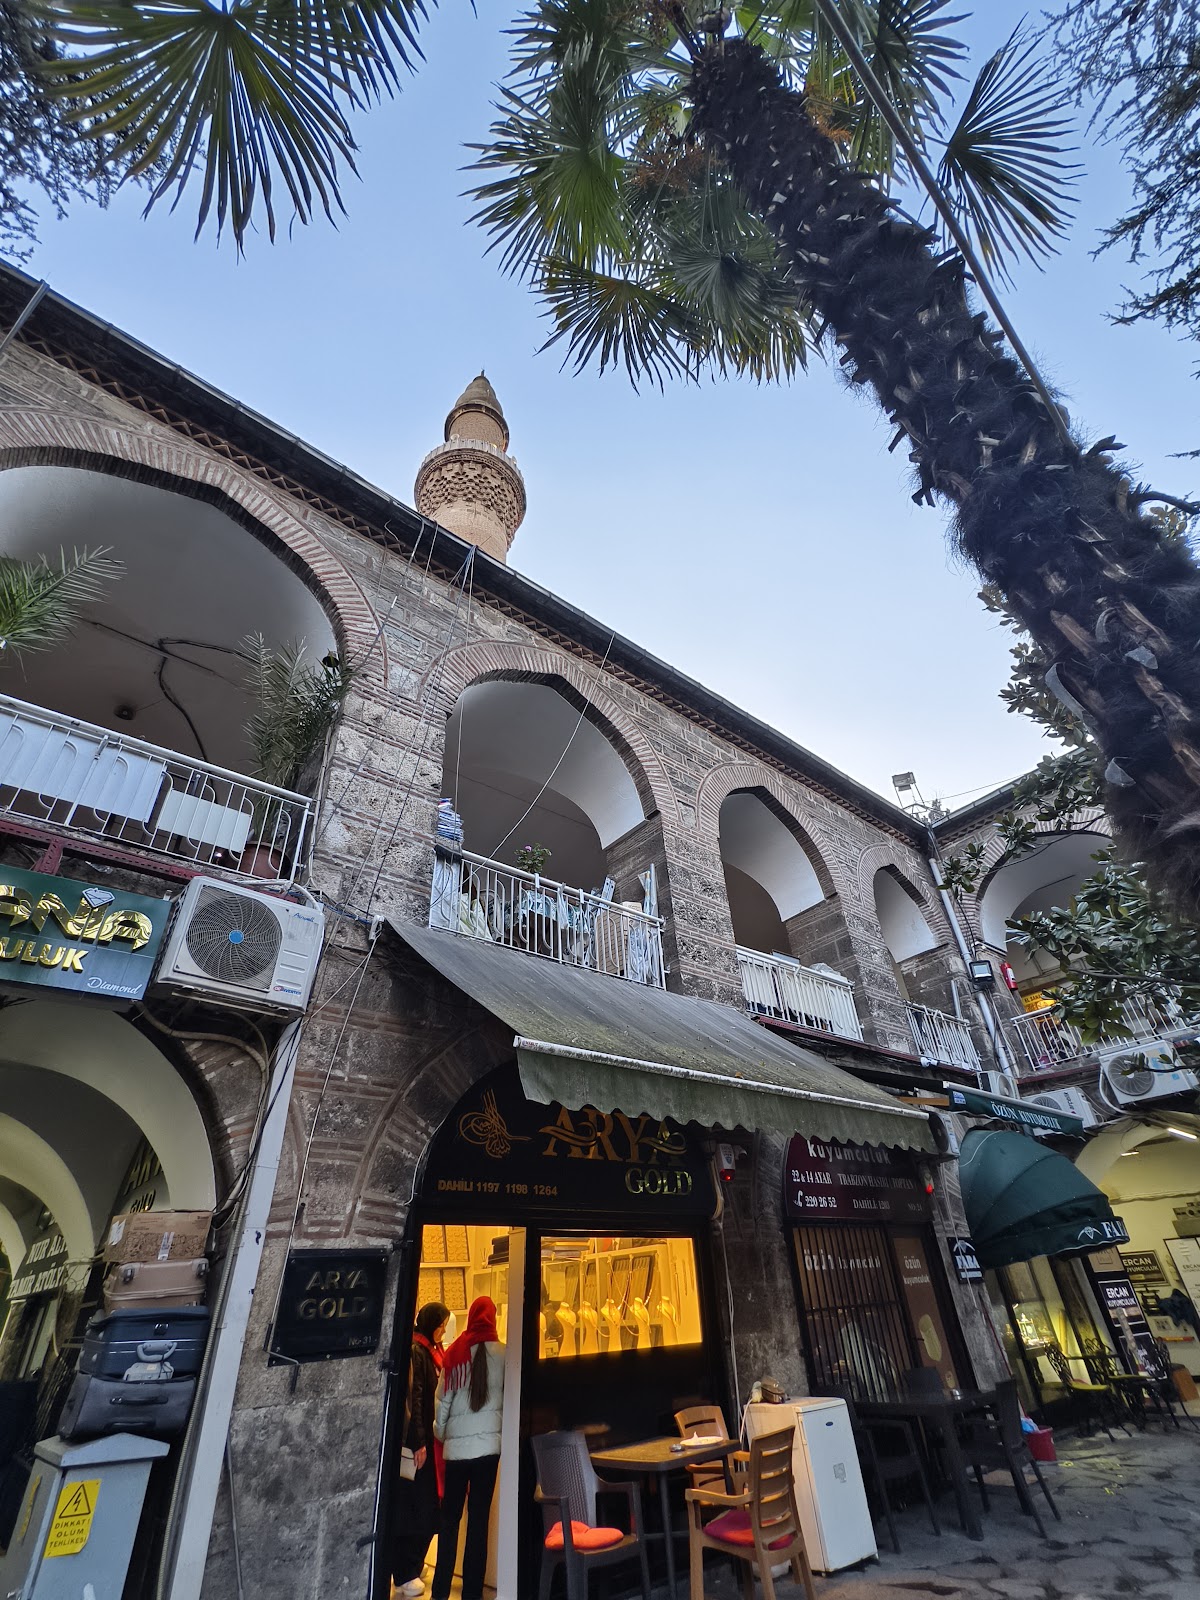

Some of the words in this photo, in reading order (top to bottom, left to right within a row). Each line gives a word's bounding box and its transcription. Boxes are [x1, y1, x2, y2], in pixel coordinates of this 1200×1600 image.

[87, 976, 143, 995] Diamond
[991, 1101, 1018, 1120] ÖZÜN
[539, 1105, 687, 1166] ARYA
[625, 1167, 693, 1196] GOLD
[814, 1171, 833, 1185] AYAR
[476, 1181, 500, 1193] 1197
[505, 1183, 528, 1195] 1198
[533, 1184, 558, 1196] 1264
[1122, 1257, 1152, 1267] ERCAN
[305, 1269, 369, 1291] ARYA
[1105, 1286, 1130, 1299] ERCAN
[299, 1296, 369, 1320] GOLD
